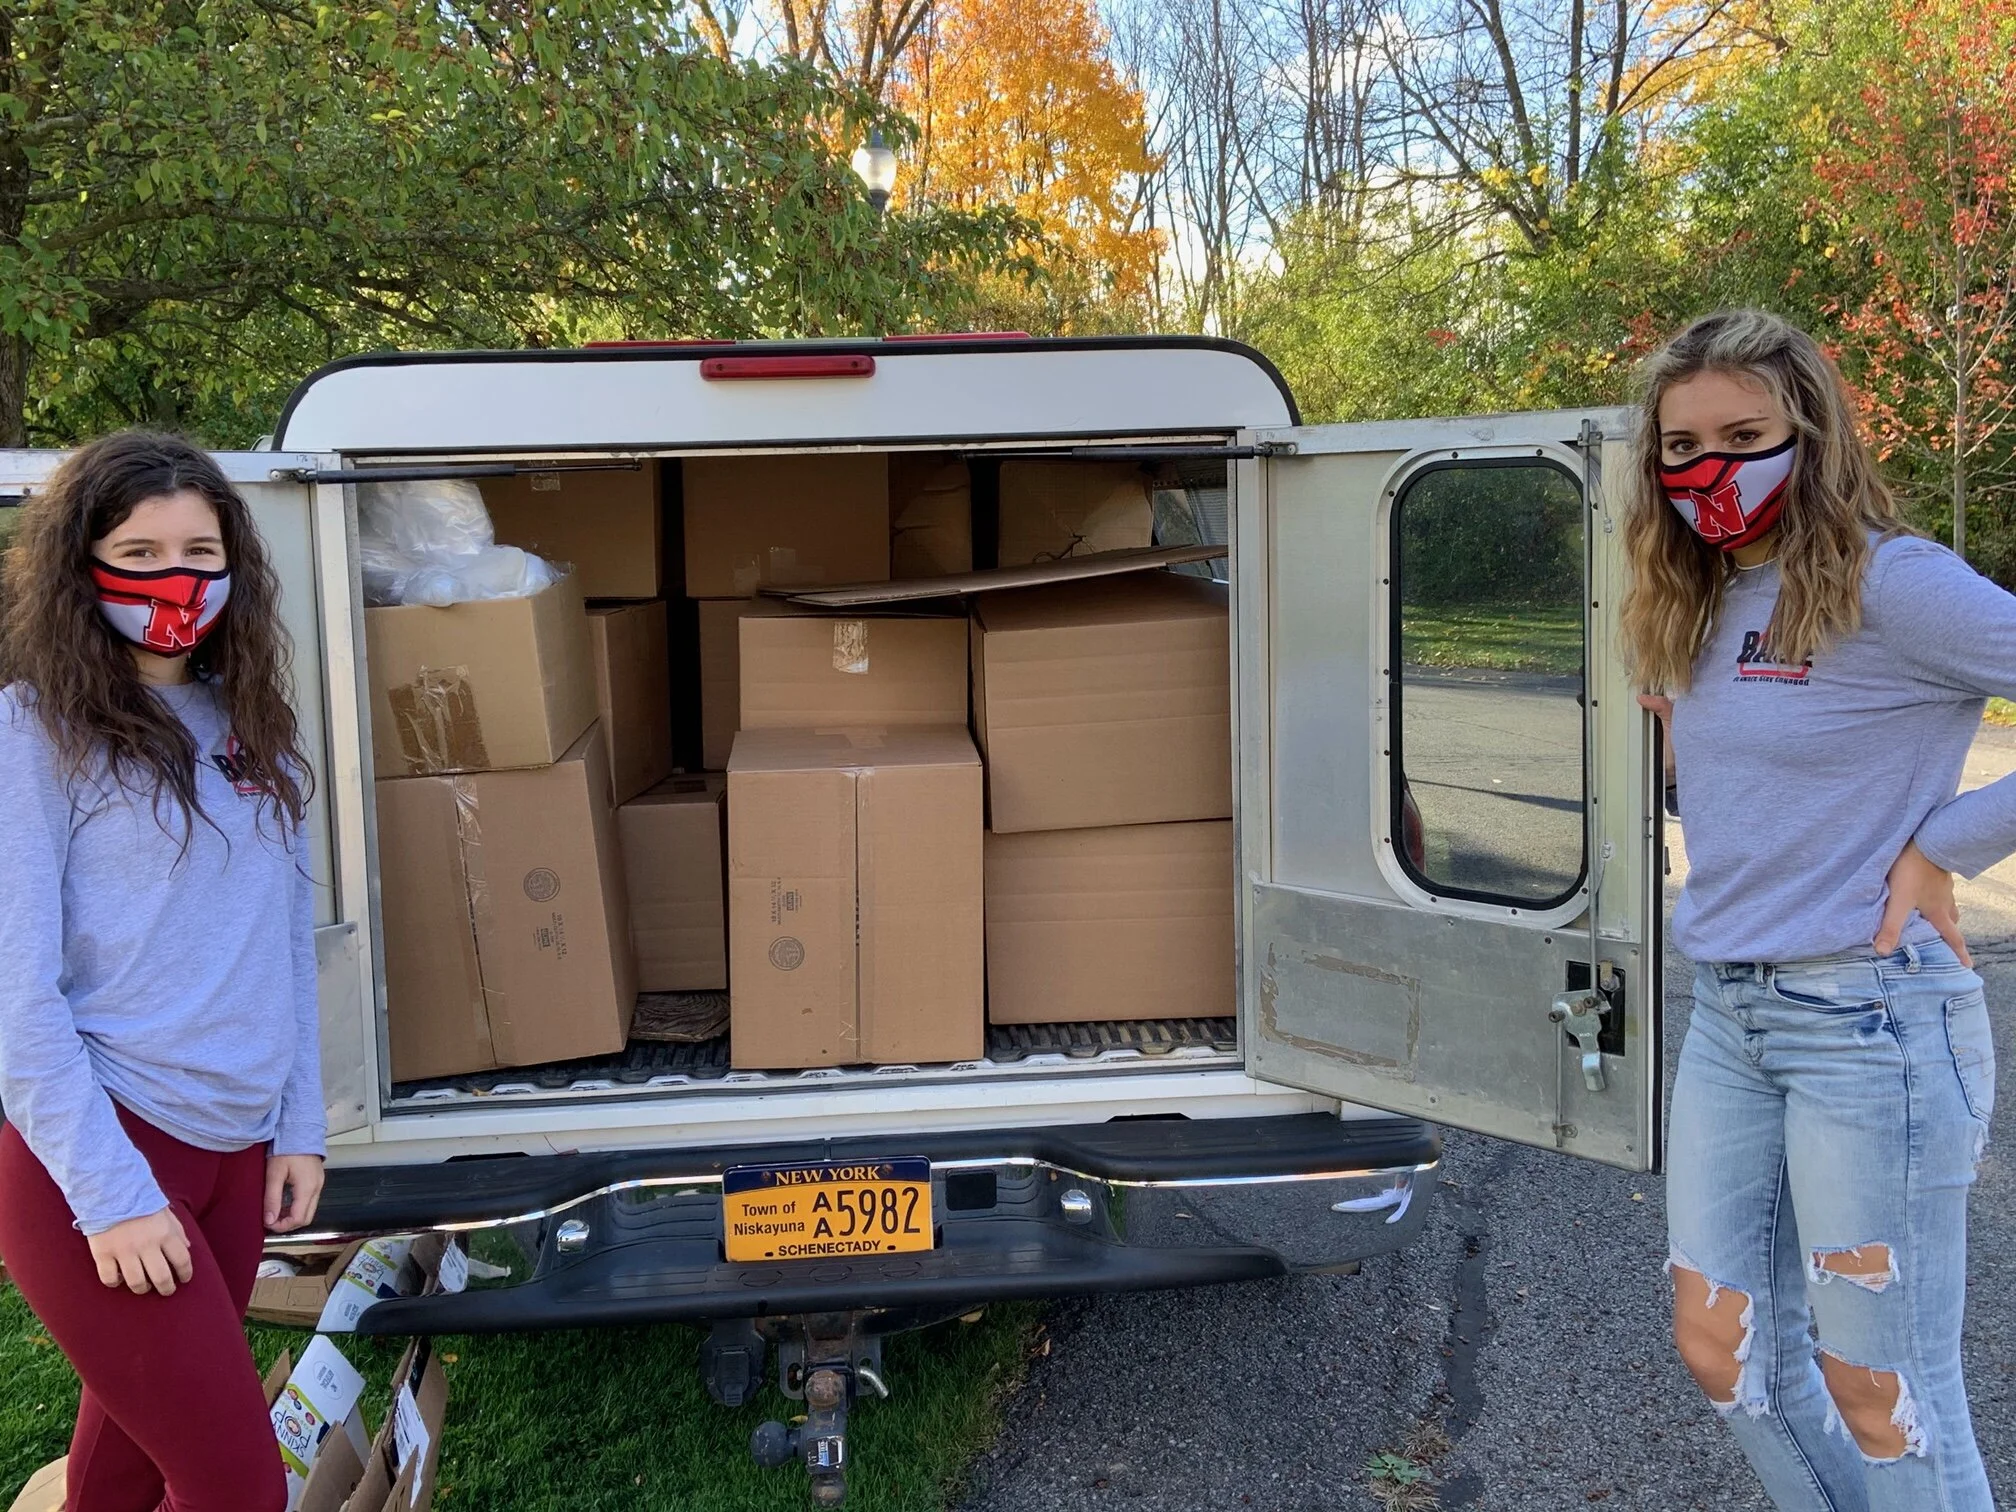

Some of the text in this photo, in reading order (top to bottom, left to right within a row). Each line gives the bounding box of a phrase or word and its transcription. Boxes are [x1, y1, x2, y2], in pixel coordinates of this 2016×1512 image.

[1688, 480, 1748, 538] N
[144, 598, 208, 648] N
[775, 1165, 881, 1186] NEW YORK
[741, 1201, 796, 1217] Town of
[734, 1221, 805, 1237] Niskayuna
[778, 1240, 881, 1257] SCHENECTADY
